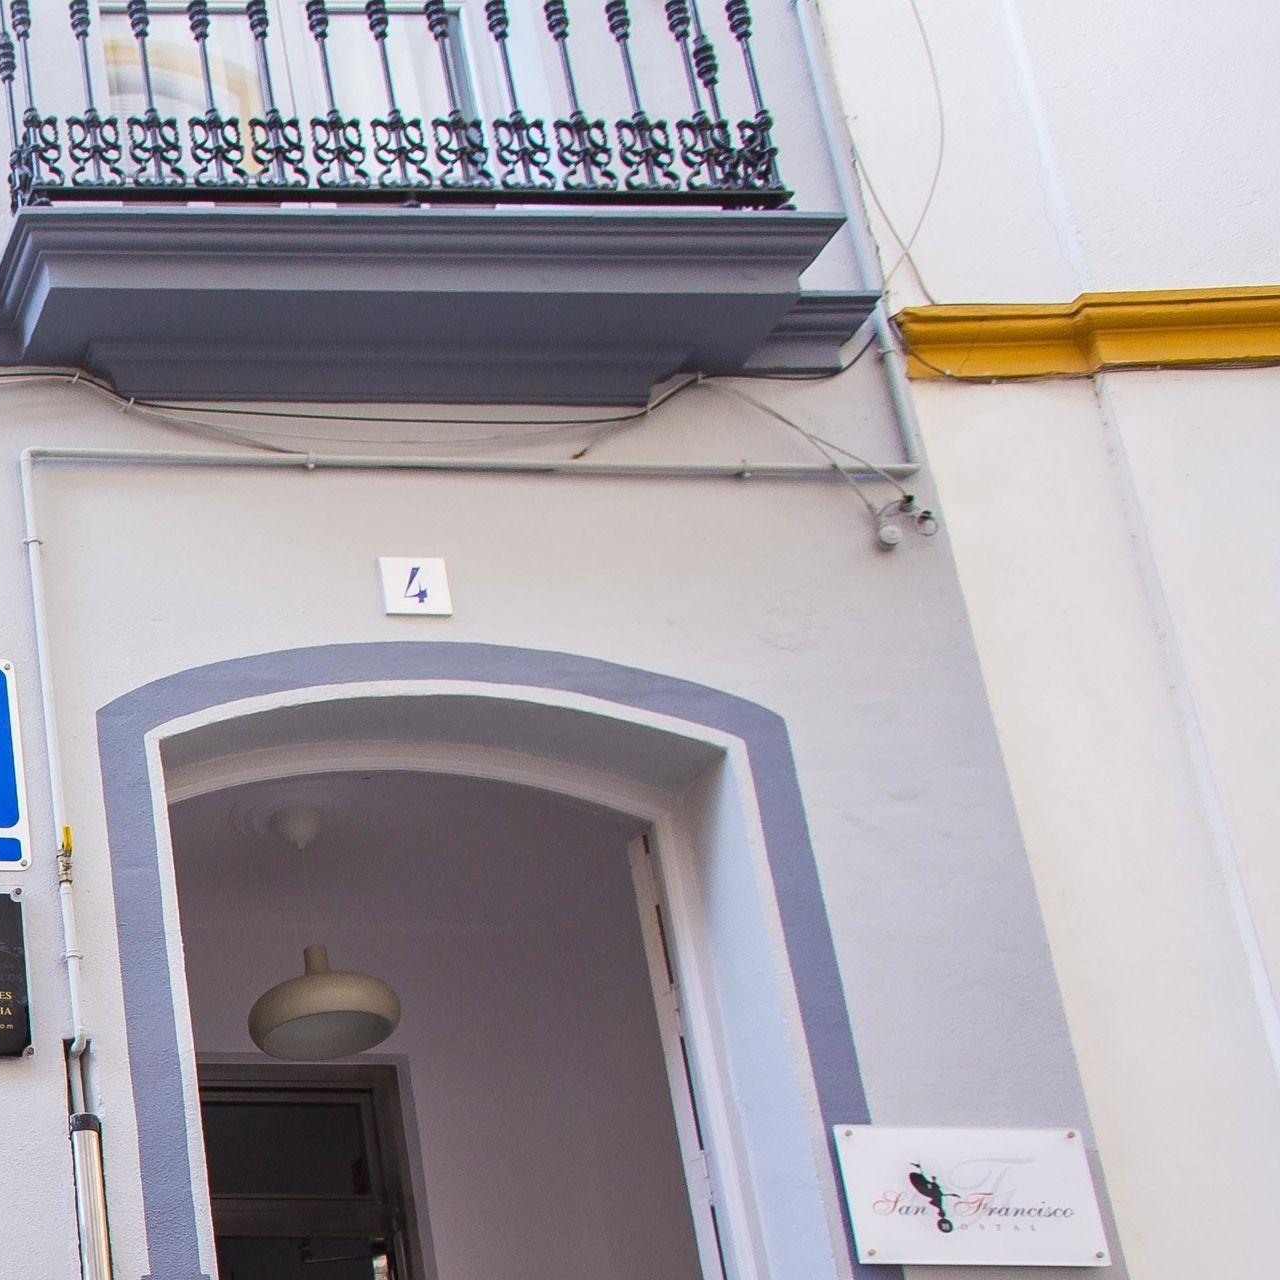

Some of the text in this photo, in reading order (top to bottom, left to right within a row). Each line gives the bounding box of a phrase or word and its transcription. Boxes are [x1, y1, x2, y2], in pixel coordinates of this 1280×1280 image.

[403, 566, 428, 603] 4
[872, 1190, 1075, 1217] San Francisco
